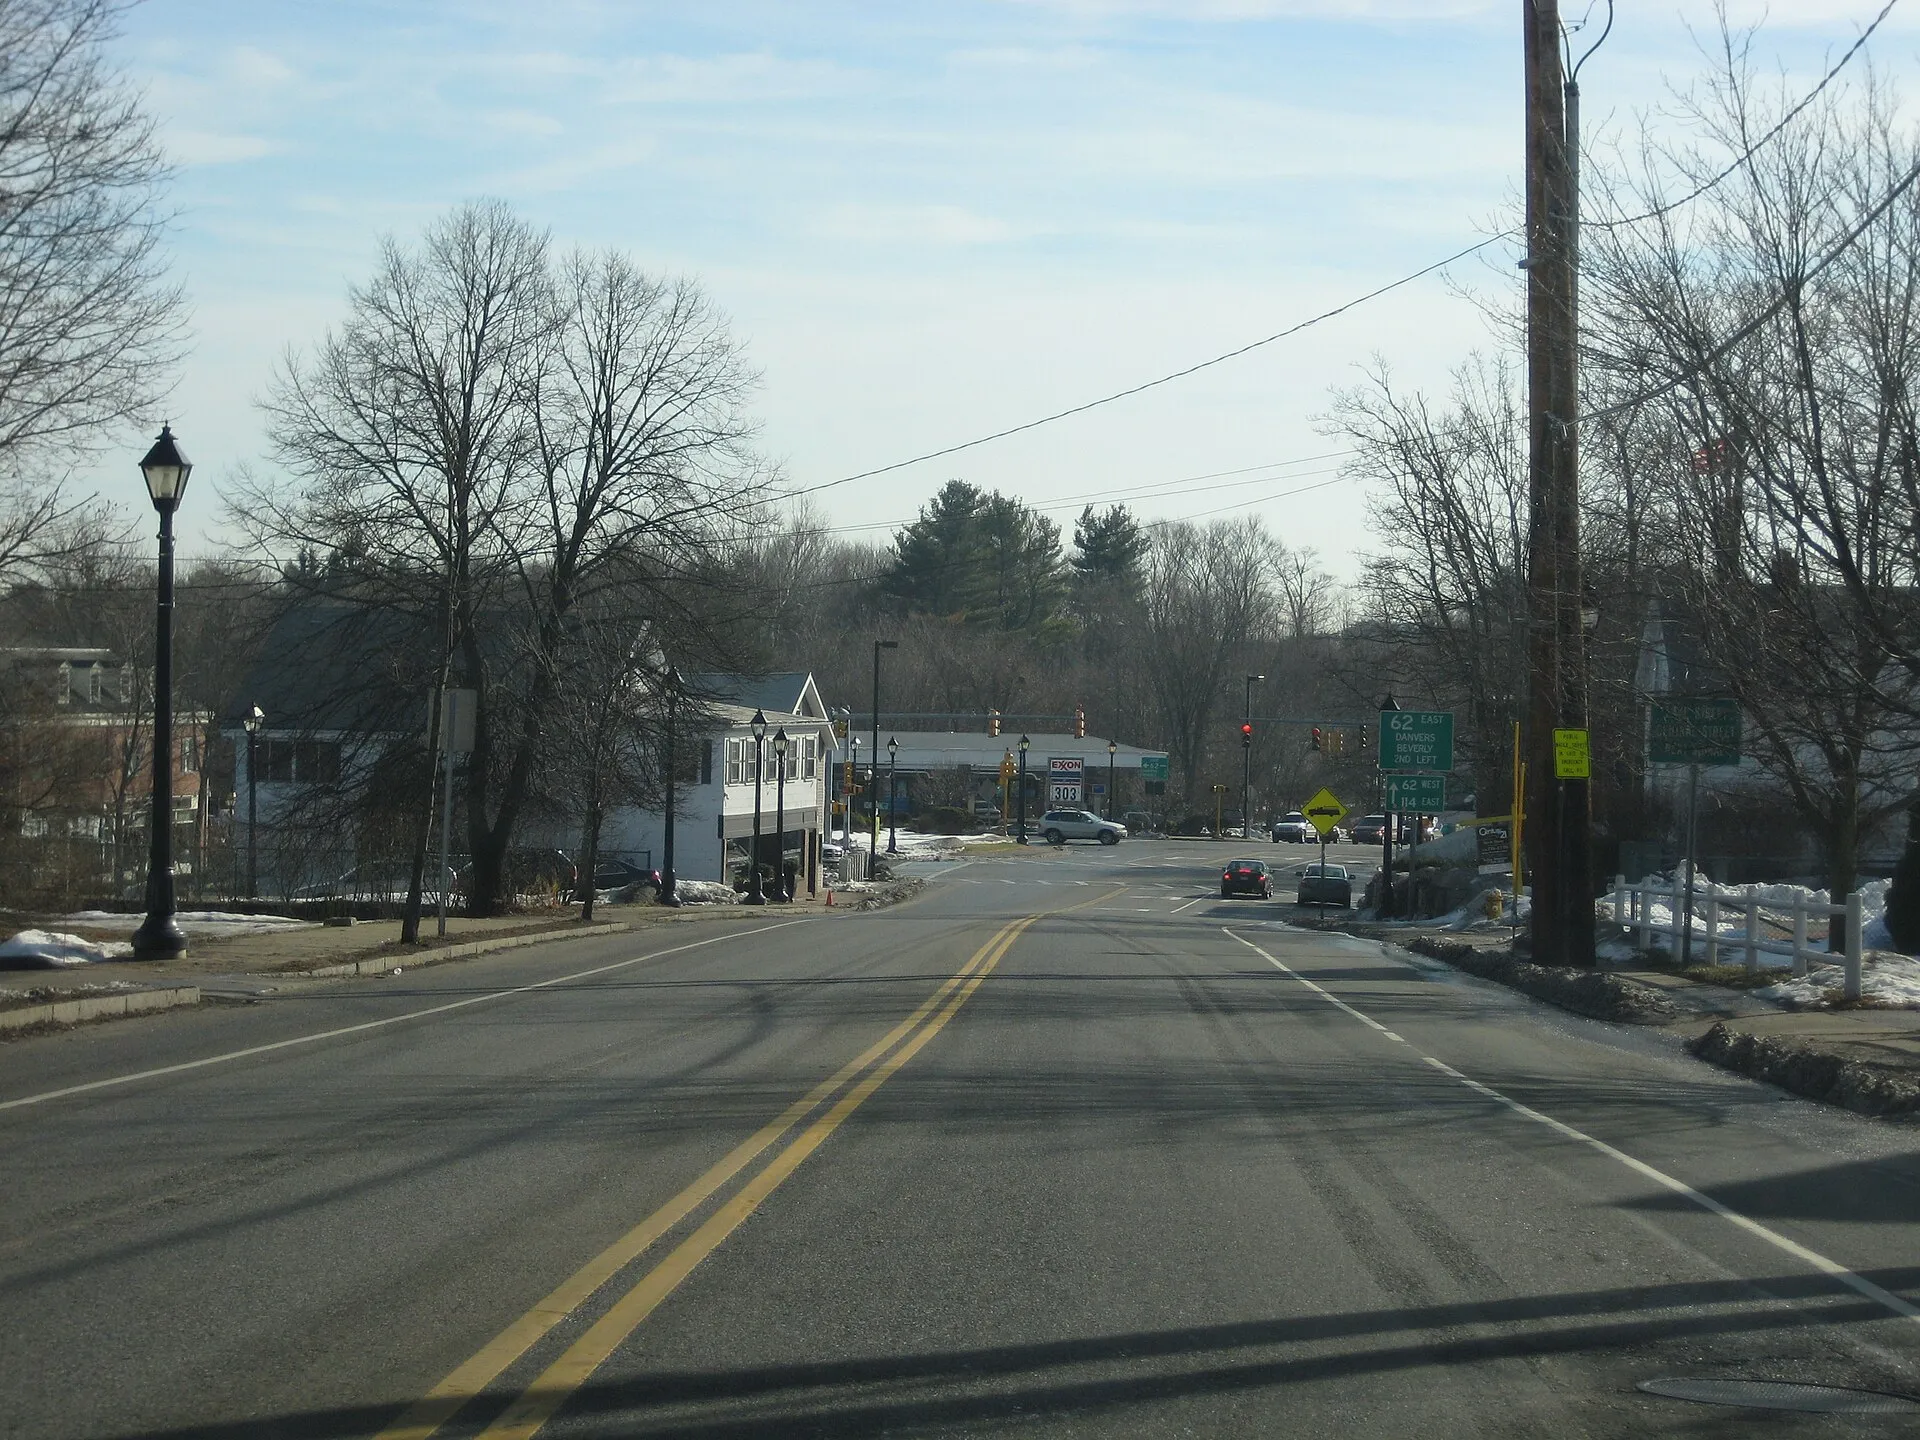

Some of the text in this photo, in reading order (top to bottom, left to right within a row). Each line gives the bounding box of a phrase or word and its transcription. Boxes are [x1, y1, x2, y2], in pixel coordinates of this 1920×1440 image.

[1390, 715, 1443, 730] 62 EAST
[1395, 733, 1436, 742] DANVERS
[1396, 744, 1434, 753] BEVERLY
[1394, 755, 1437, 764] 2ND LEFT
[1052, 761, 1081, 770] EXXON
[1402, 780, 1440, 790] 62 WEST
[1055, 787, 1077, 800] 303
[1401, 797, 1440, 807] 114 EAST
